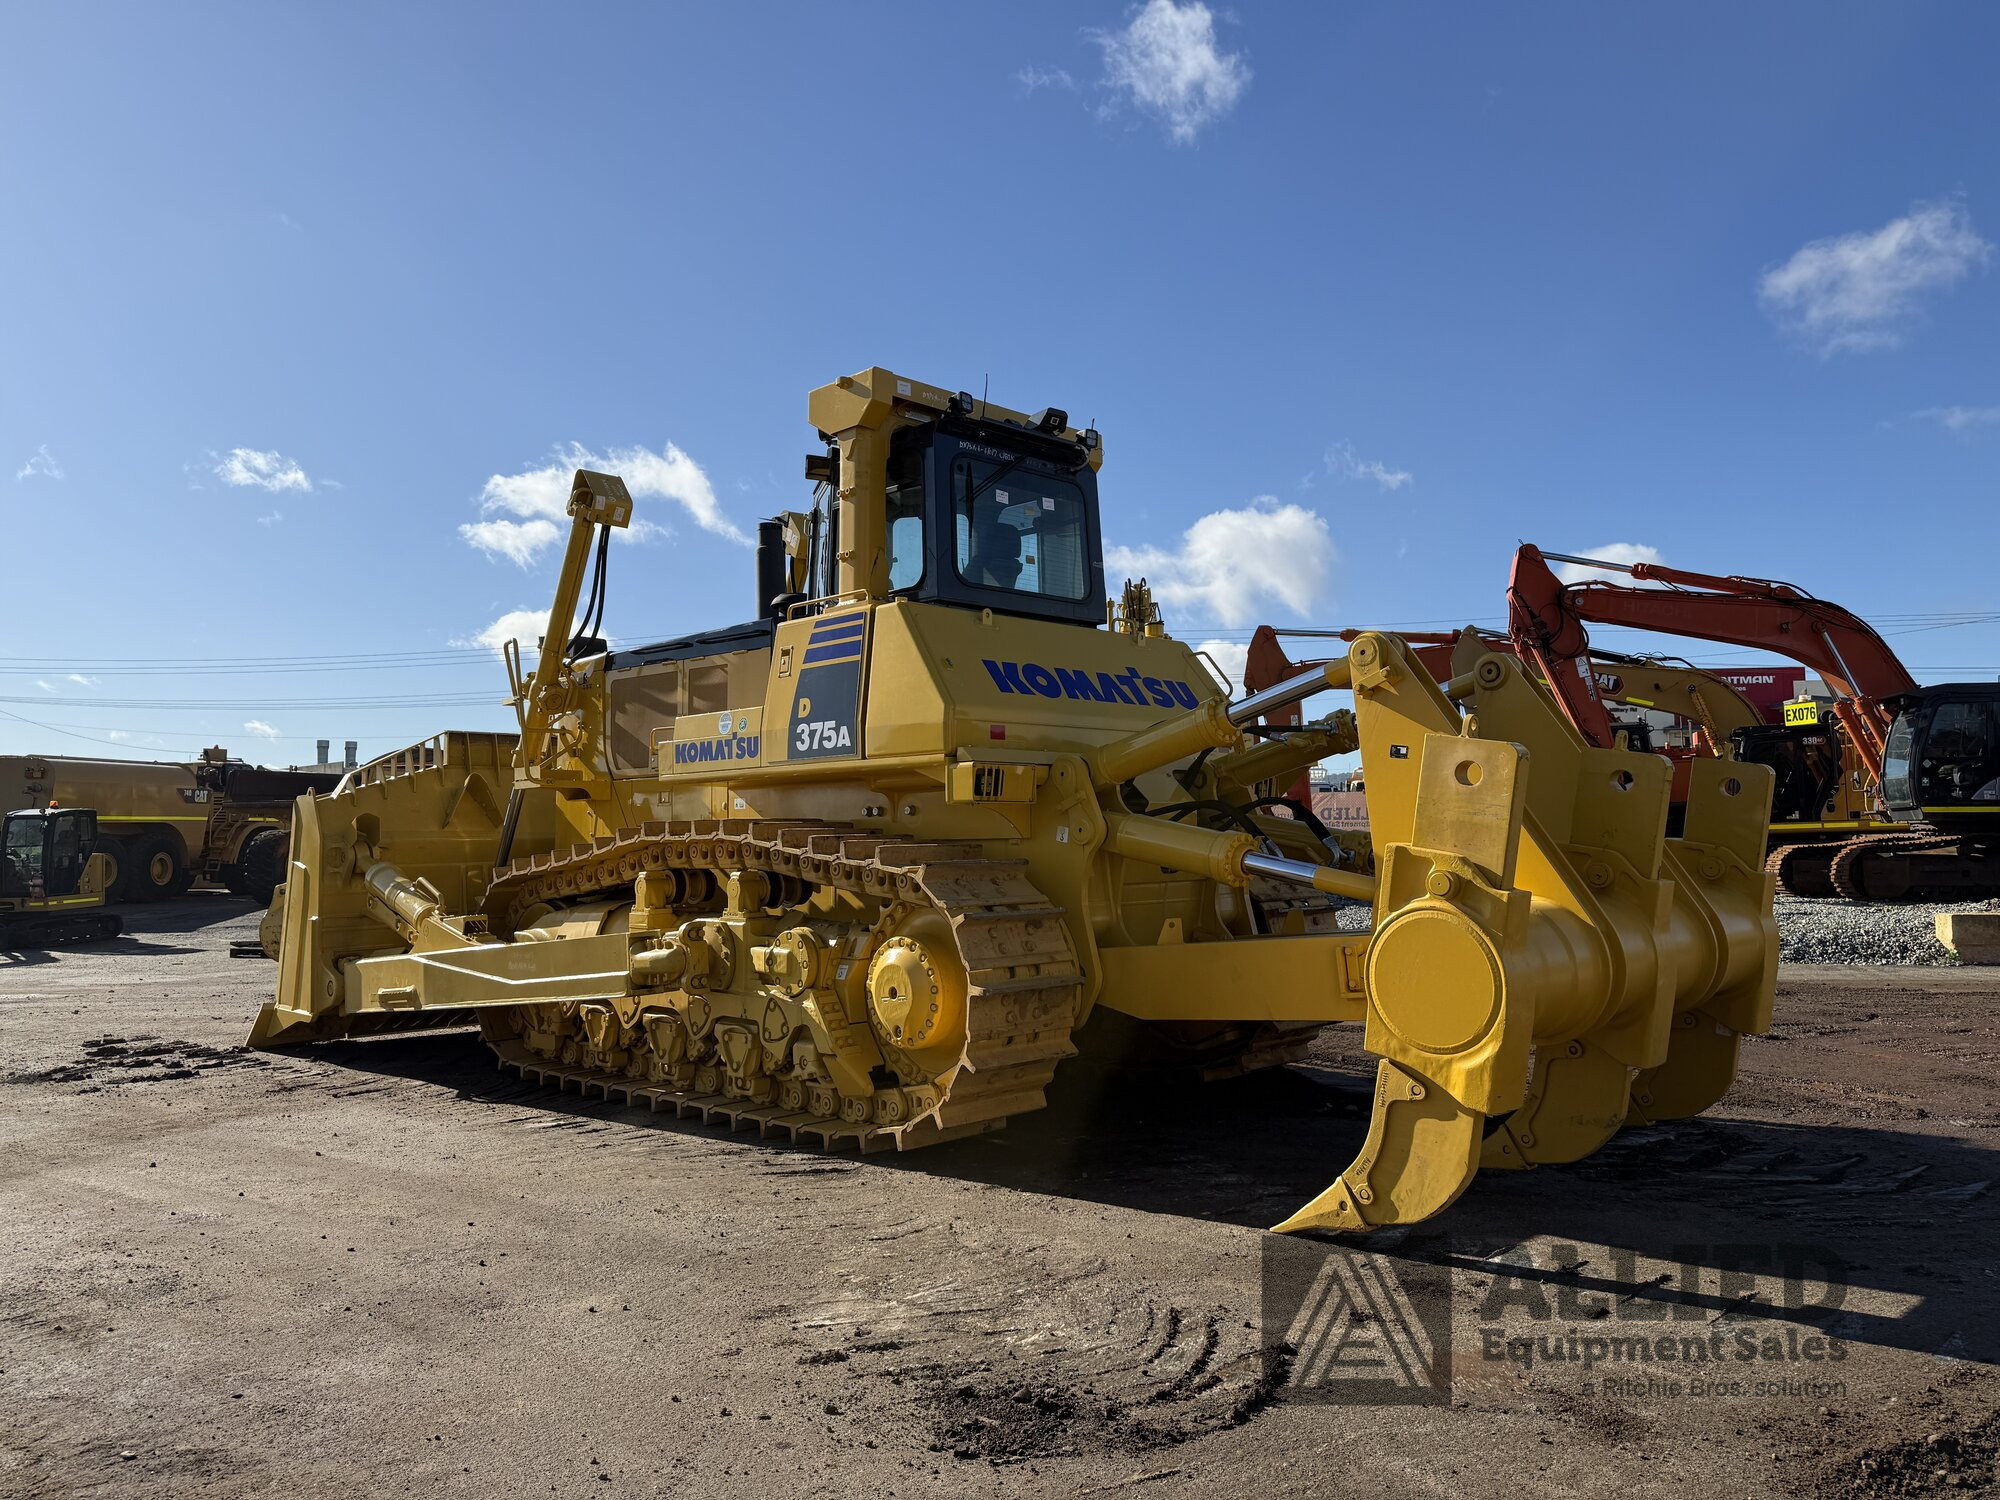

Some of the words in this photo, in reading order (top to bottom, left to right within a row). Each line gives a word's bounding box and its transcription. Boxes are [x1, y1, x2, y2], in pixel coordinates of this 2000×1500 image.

[981, 659, 1199, 710] KOMATSU
[798, 698, 811, 718] D
[1785, 706, 1816, 722] EX076
[675, 731, 759, 764] KOMATSU
[795, 720, 852, 751] 375A
[194, 790, 208, 803] CAT
